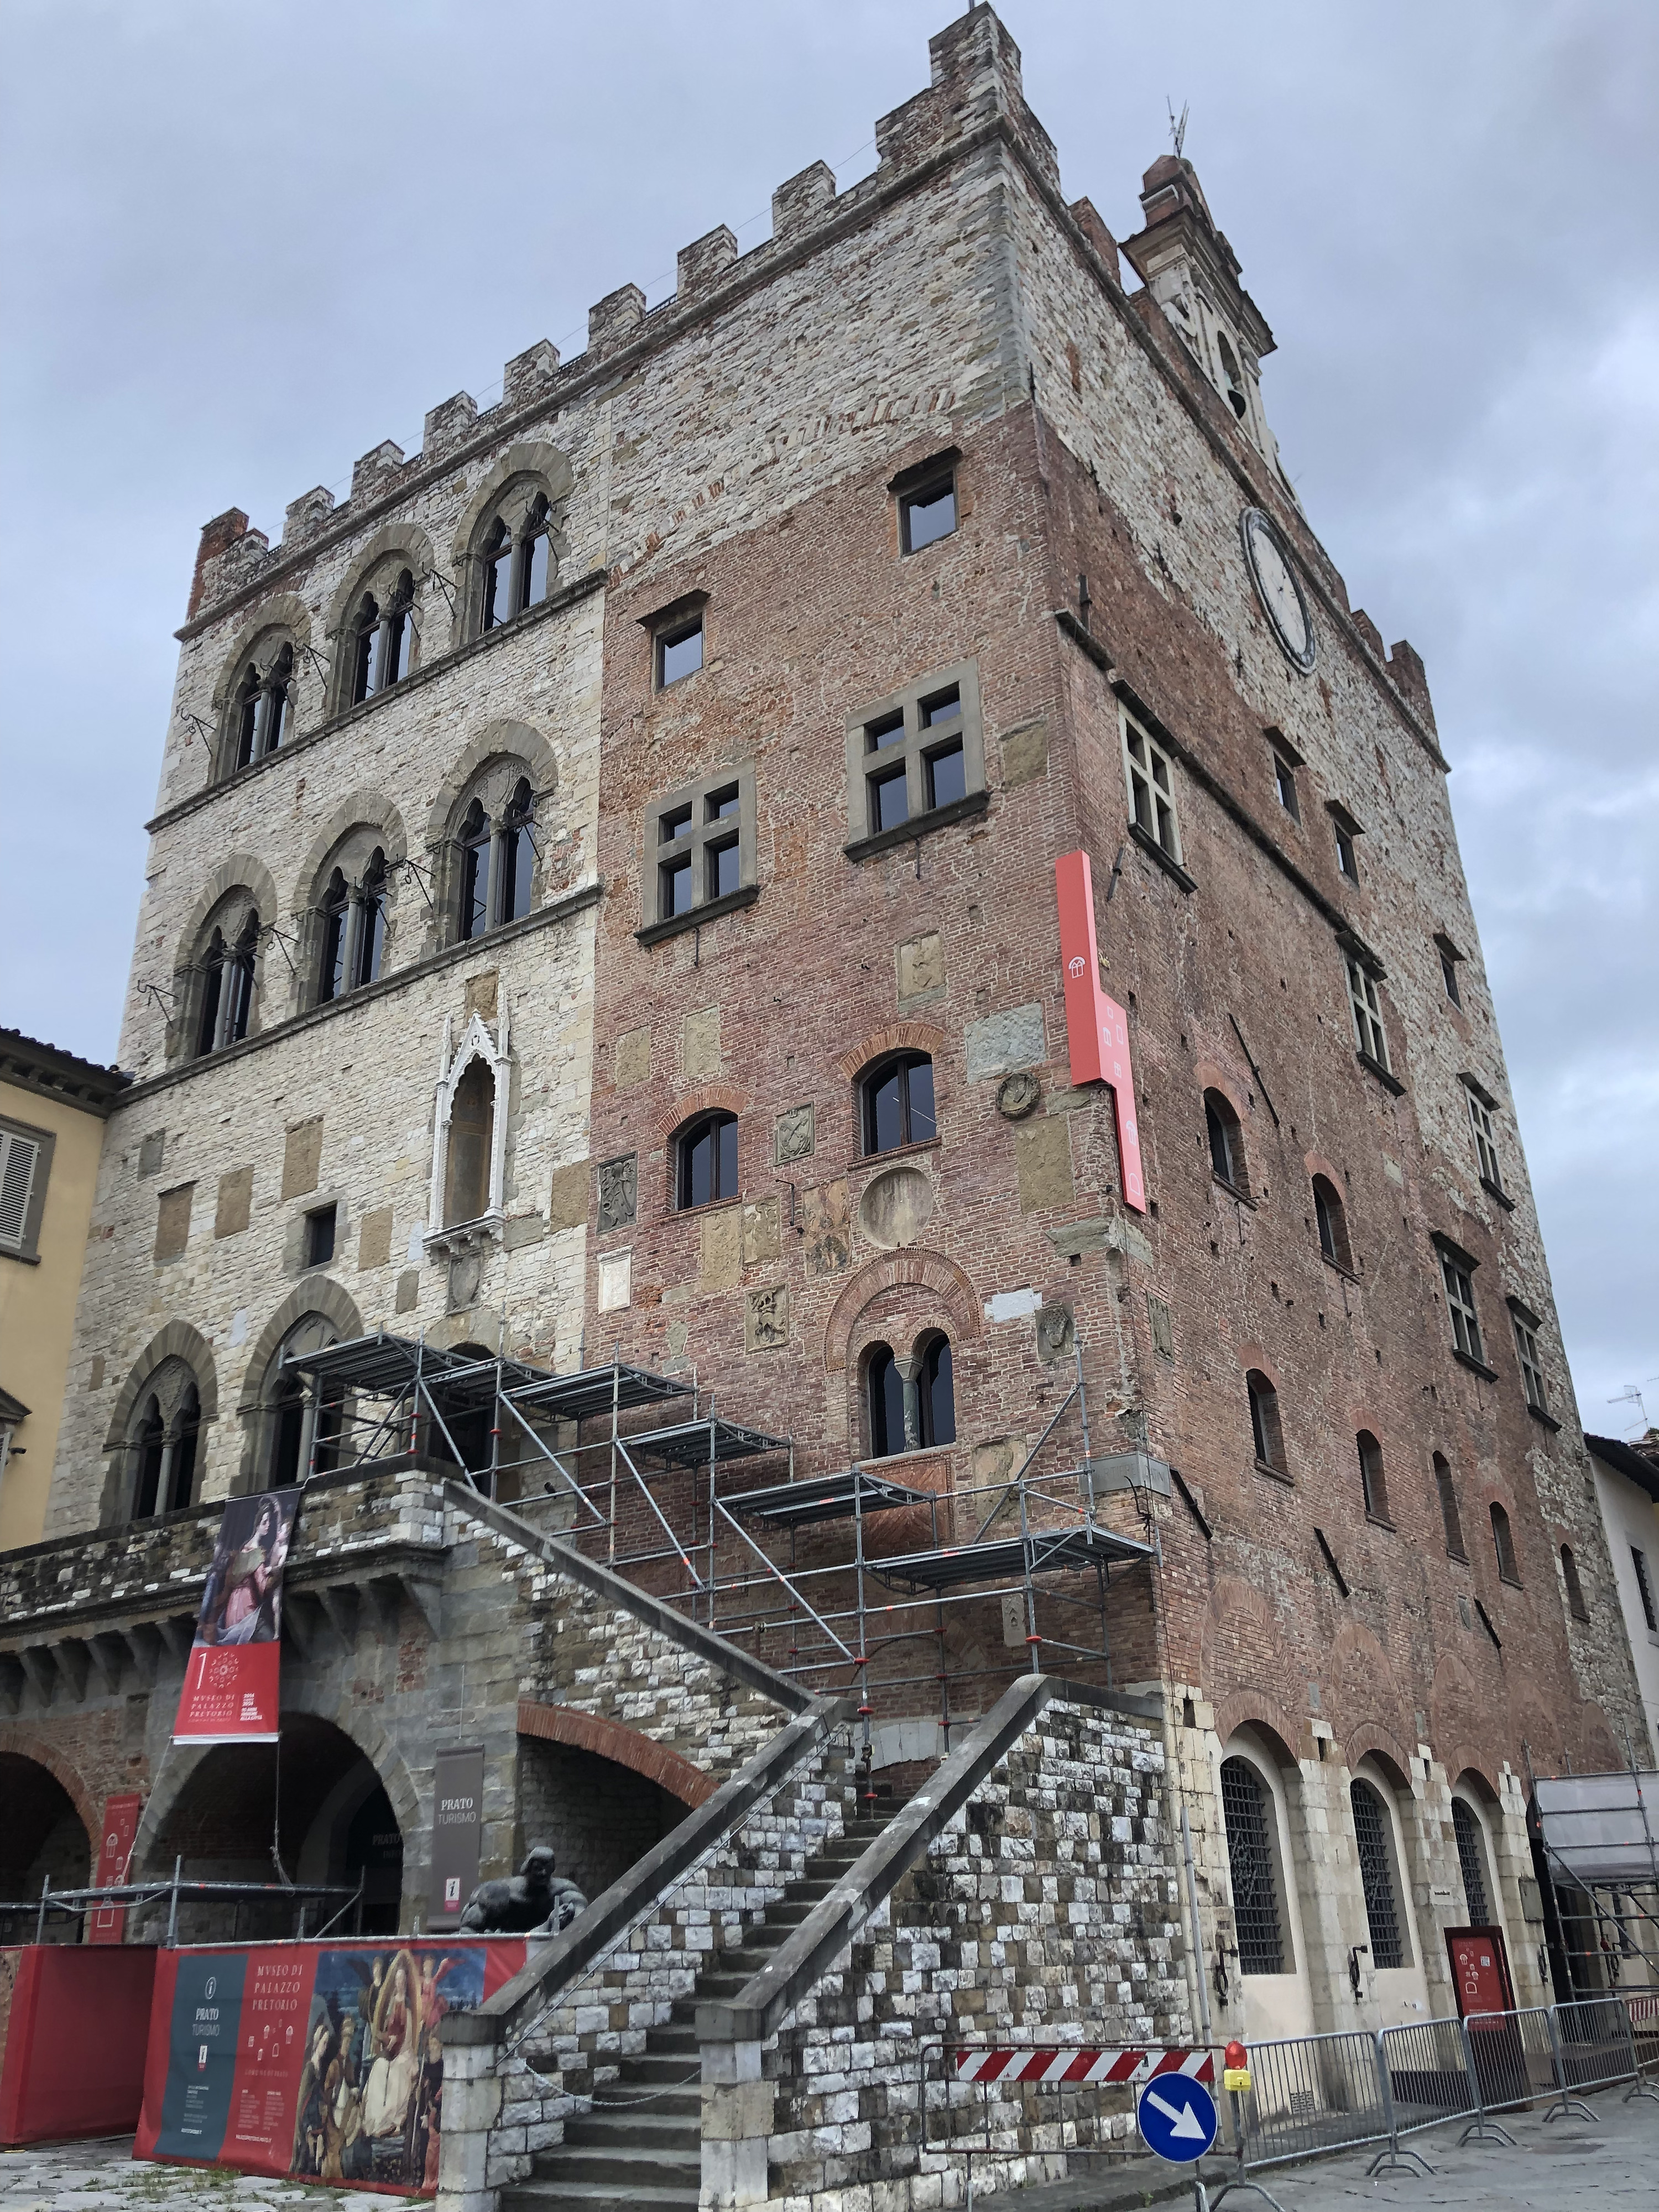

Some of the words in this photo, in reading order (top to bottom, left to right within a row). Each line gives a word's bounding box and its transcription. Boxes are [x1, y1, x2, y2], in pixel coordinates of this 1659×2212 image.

[441, 1797, 473, 1811] PRATO
[438, 1811, 476, 1825] TURISMO
[372, 1833, 400, 1845] PRATO
[258, 1965, 289, 1976] MVSEO
[291, 1964, 303, 1976] DI
[254, 1981, 300, 1994] PALAZZO
[252, 1999, 298, 2011] PRETORIO
[195, 2008, 219, 2021] PRATO
[192, 2023, 220, 2036] TURISMO
